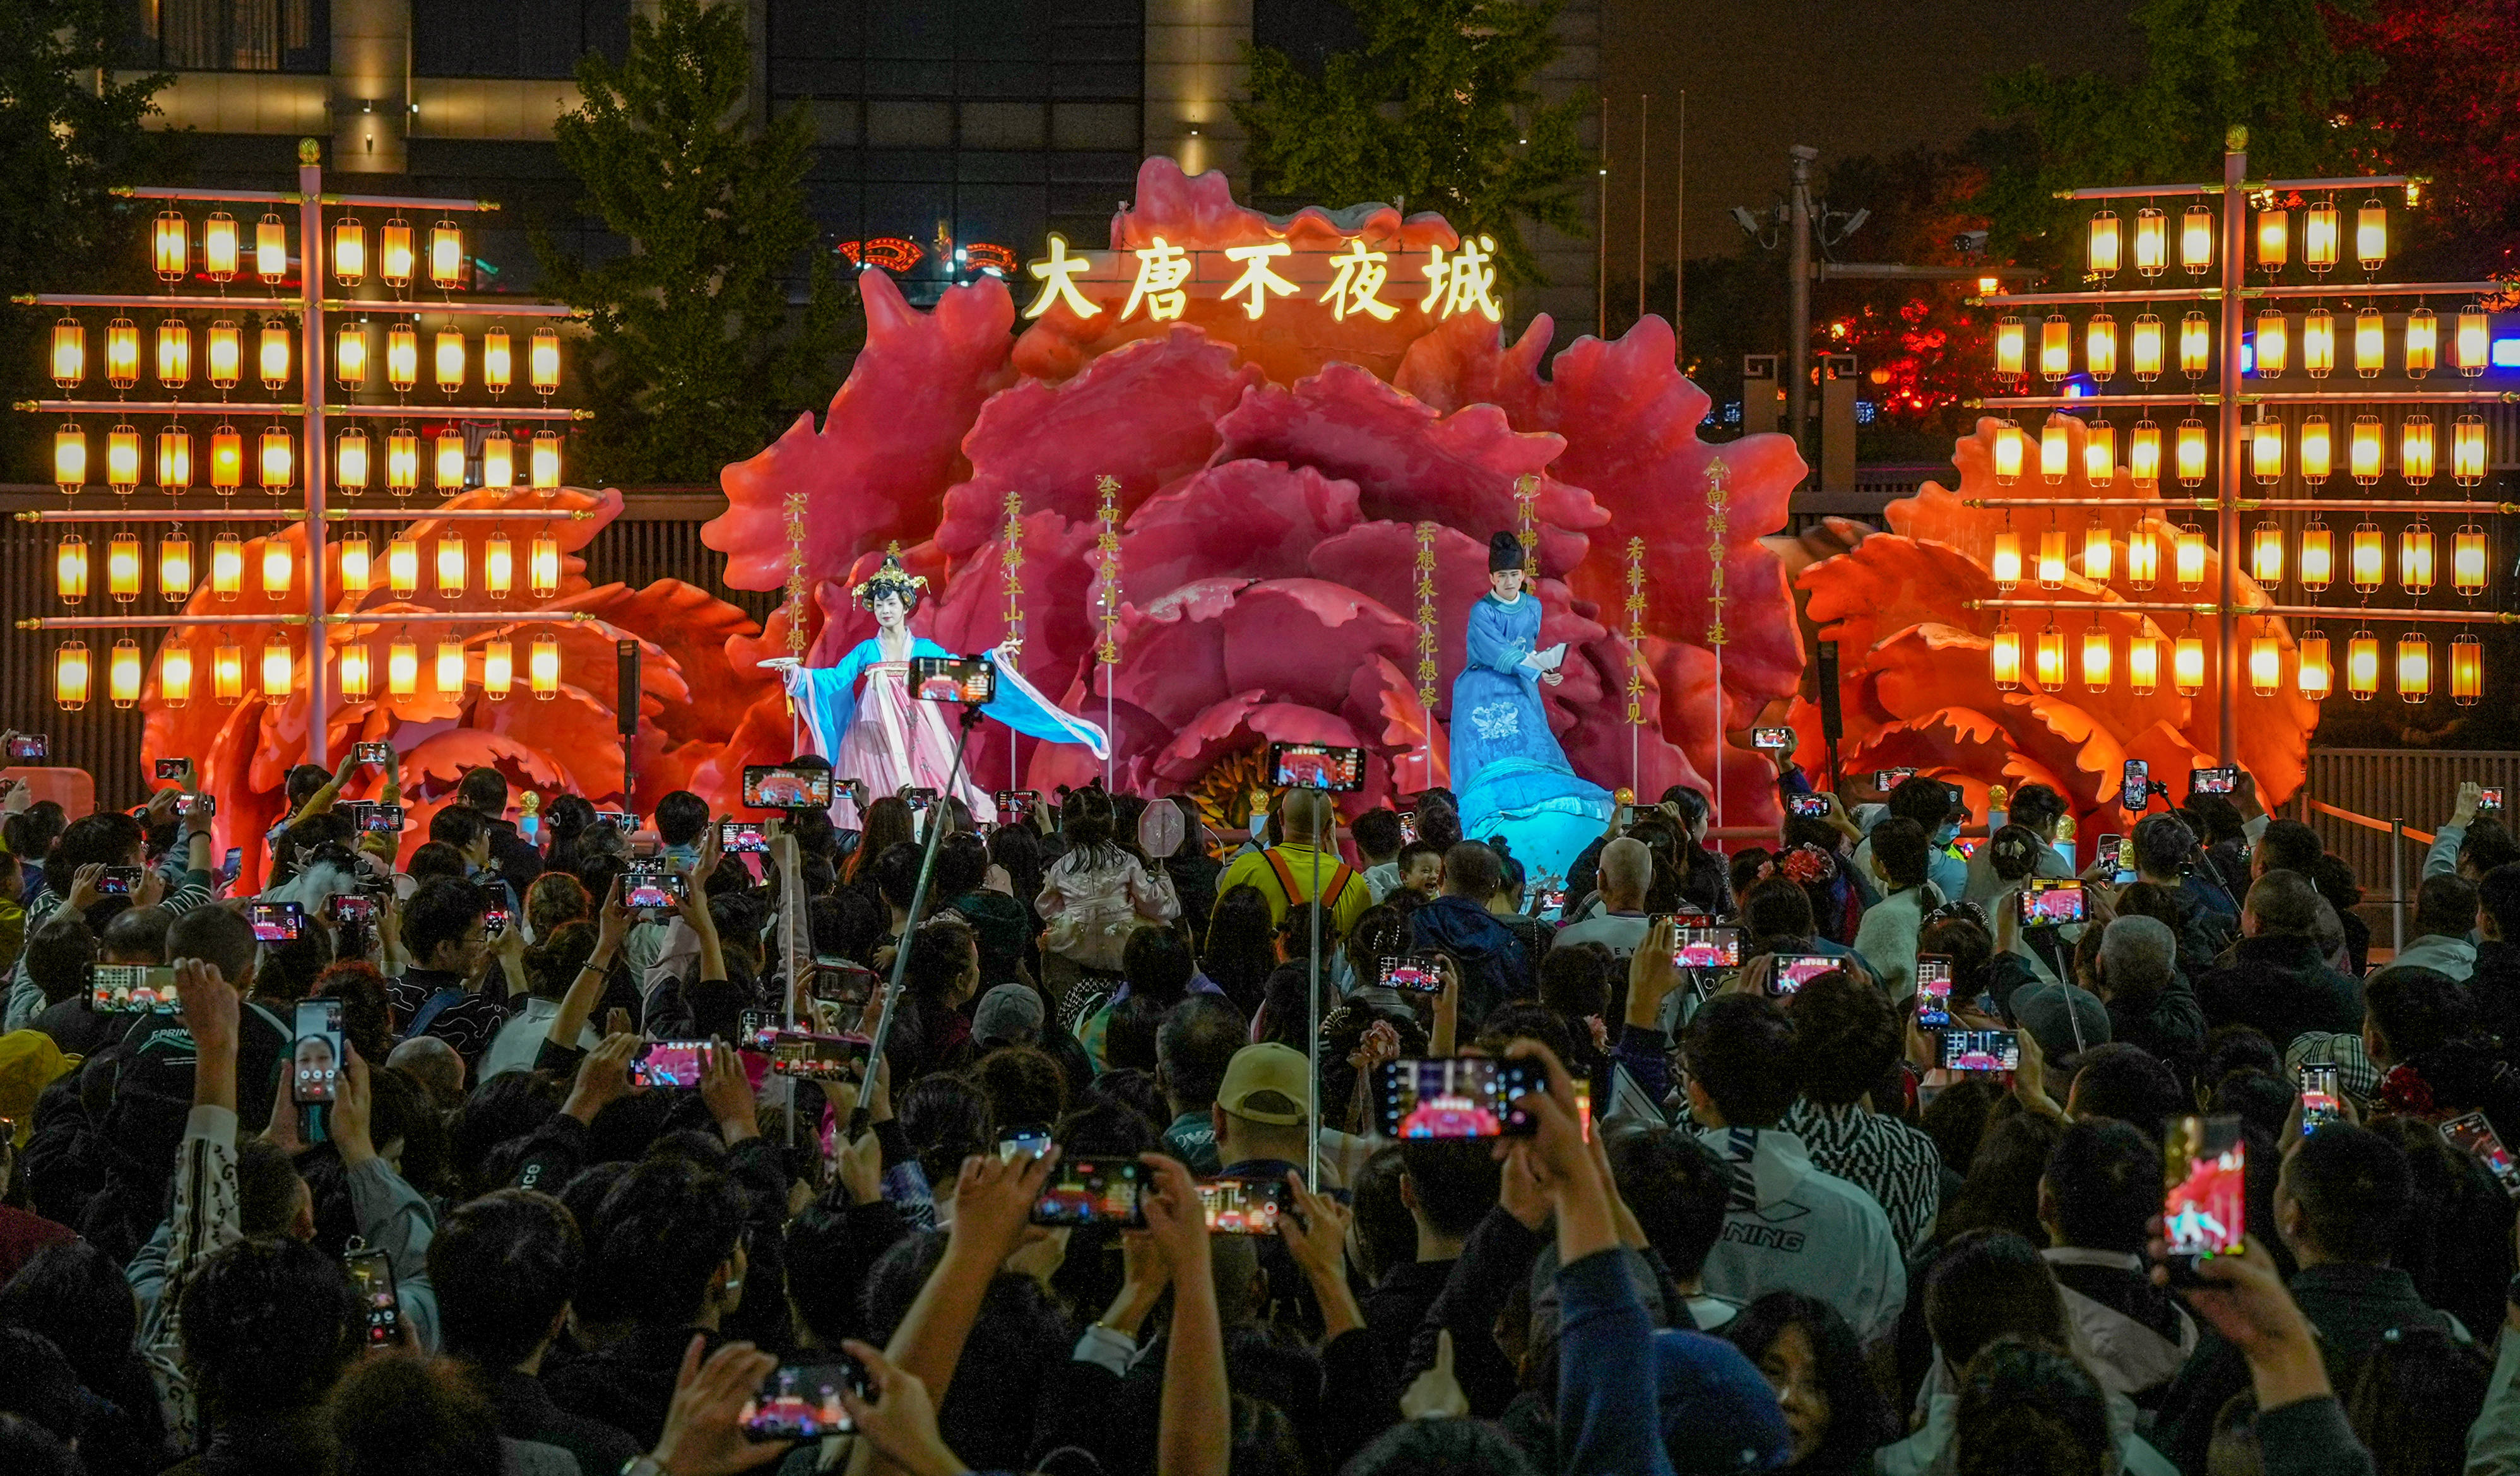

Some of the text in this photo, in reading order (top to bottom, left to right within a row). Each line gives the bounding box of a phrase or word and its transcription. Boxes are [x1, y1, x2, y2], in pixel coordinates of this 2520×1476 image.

[1024, 233, 1503, 322] 大唐不夜城
[785, 493, 807, 664] 云想衣裳花想
[1097, 475, 1120, 663] 会向瑶台月下逢
[1415, 521, 1439, 708] 云想衣裳花想容
[1624, 537, 1647, 724] 若非群玉山头见
